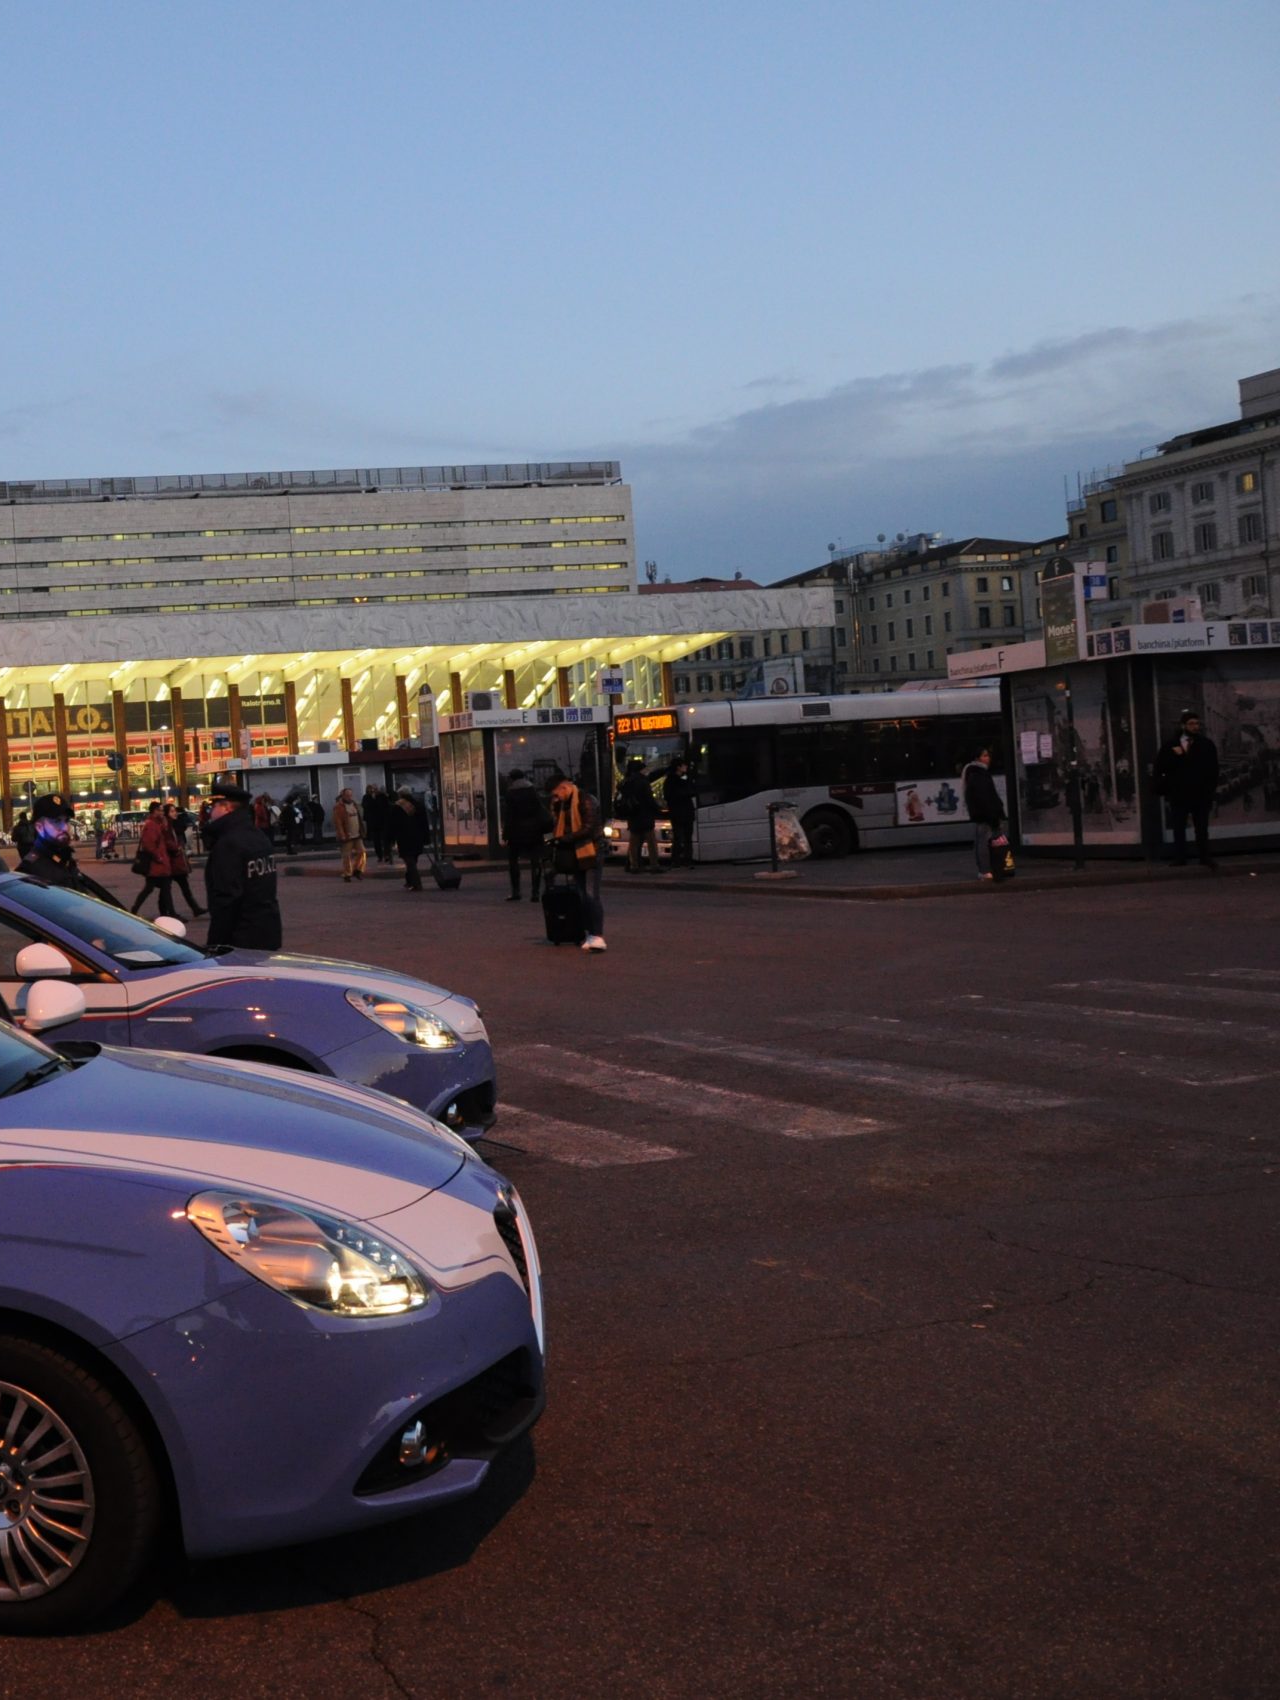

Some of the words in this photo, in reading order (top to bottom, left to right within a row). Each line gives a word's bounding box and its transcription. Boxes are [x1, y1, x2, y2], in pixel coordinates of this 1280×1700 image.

[1047, 623, 1076, 638] Monet
[1206, 626, 1215, 646] F
[998, 651, 1005, 669] F
[5, 706, 110, 736] ITALO.
[522, 711, 528, 723] E
